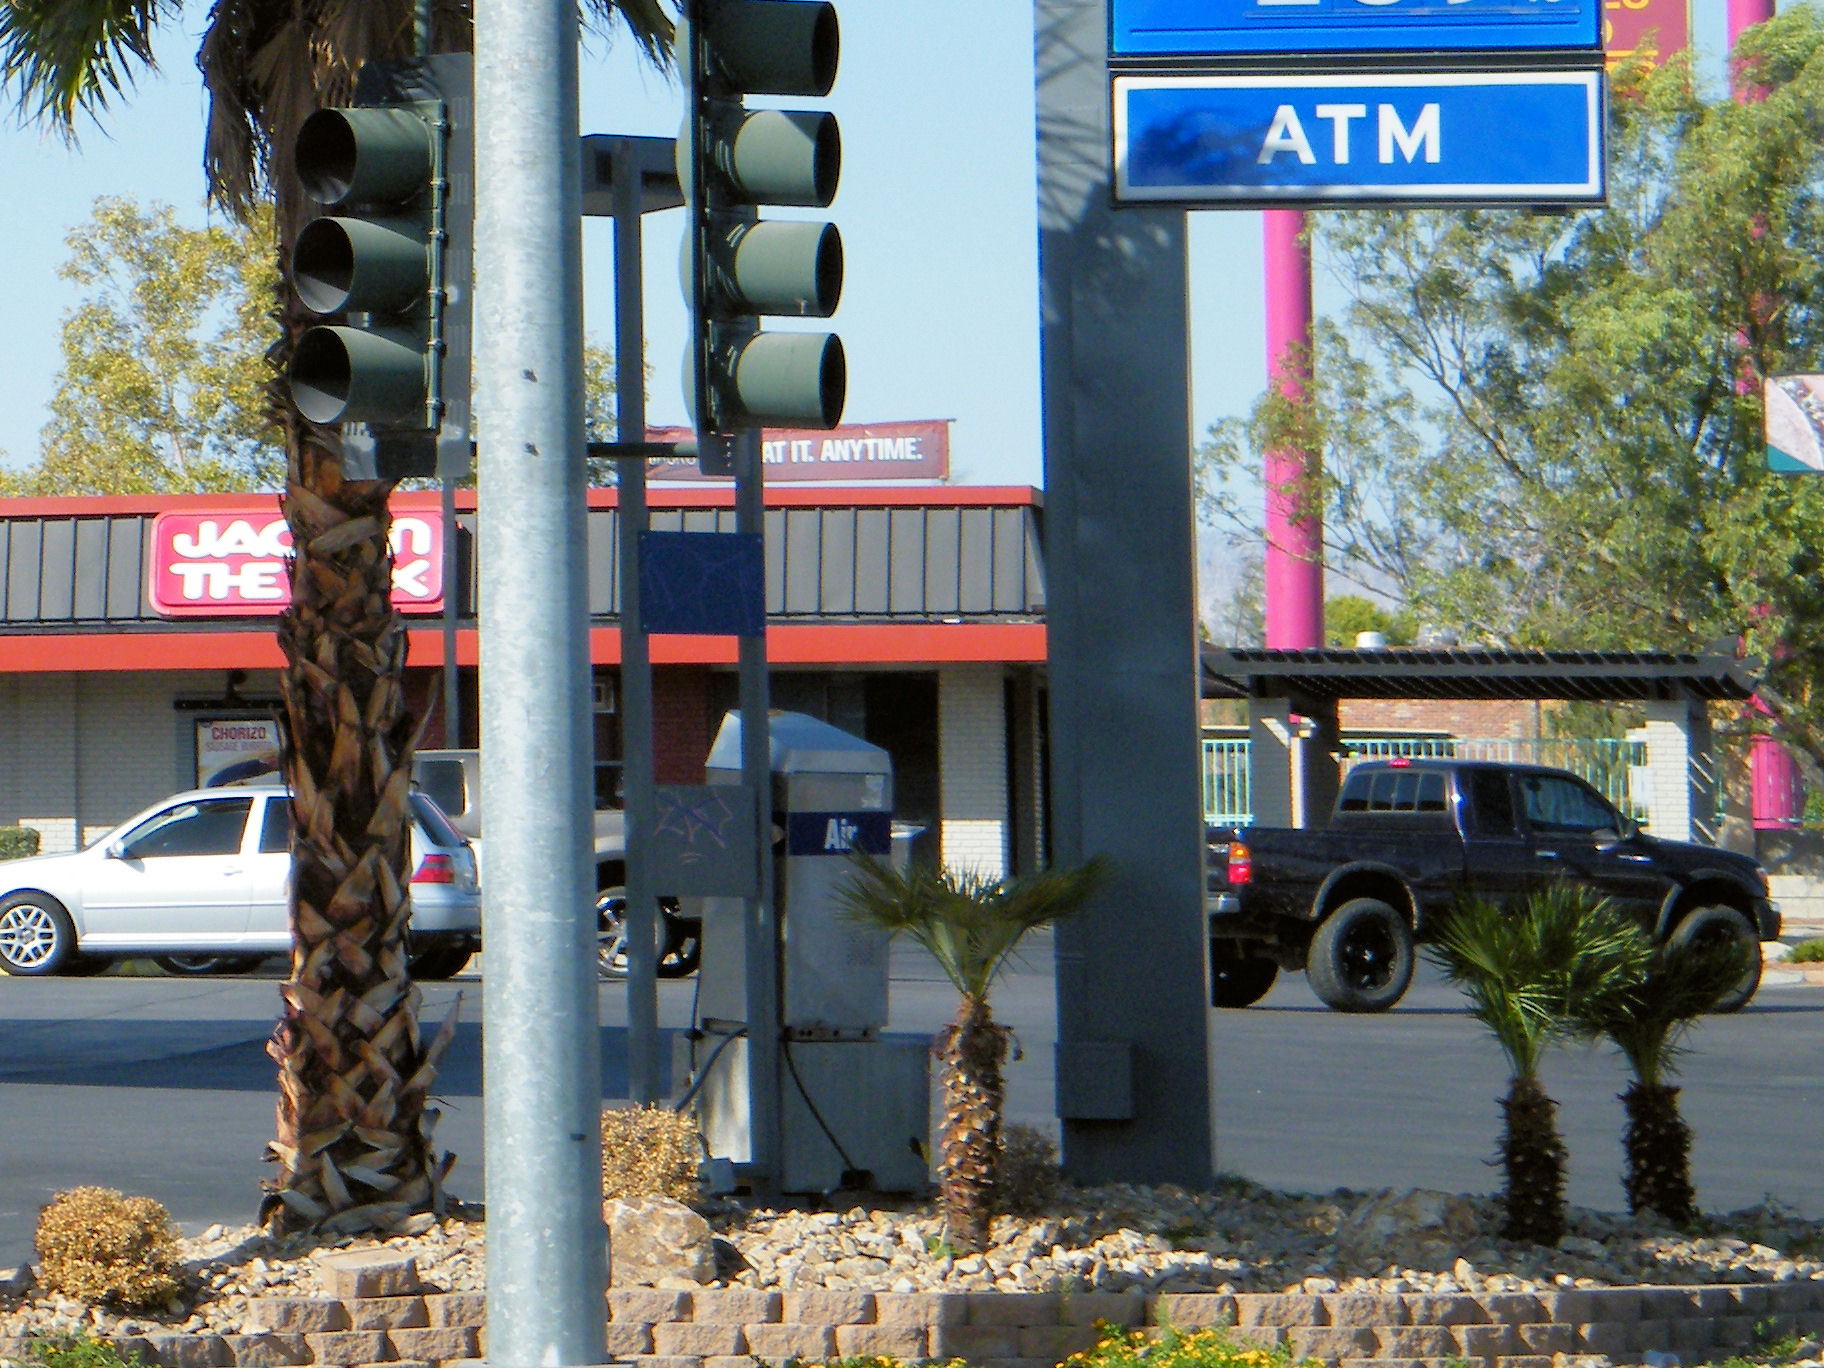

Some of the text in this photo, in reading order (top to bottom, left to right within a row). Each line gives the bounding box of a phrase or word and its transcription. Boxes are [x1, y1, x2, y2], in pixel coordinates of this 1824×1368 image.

[1257, 103, 1441, 165] ATM
[169, 562, 284, 601] THE
[824, 818, 859, 850] Air
